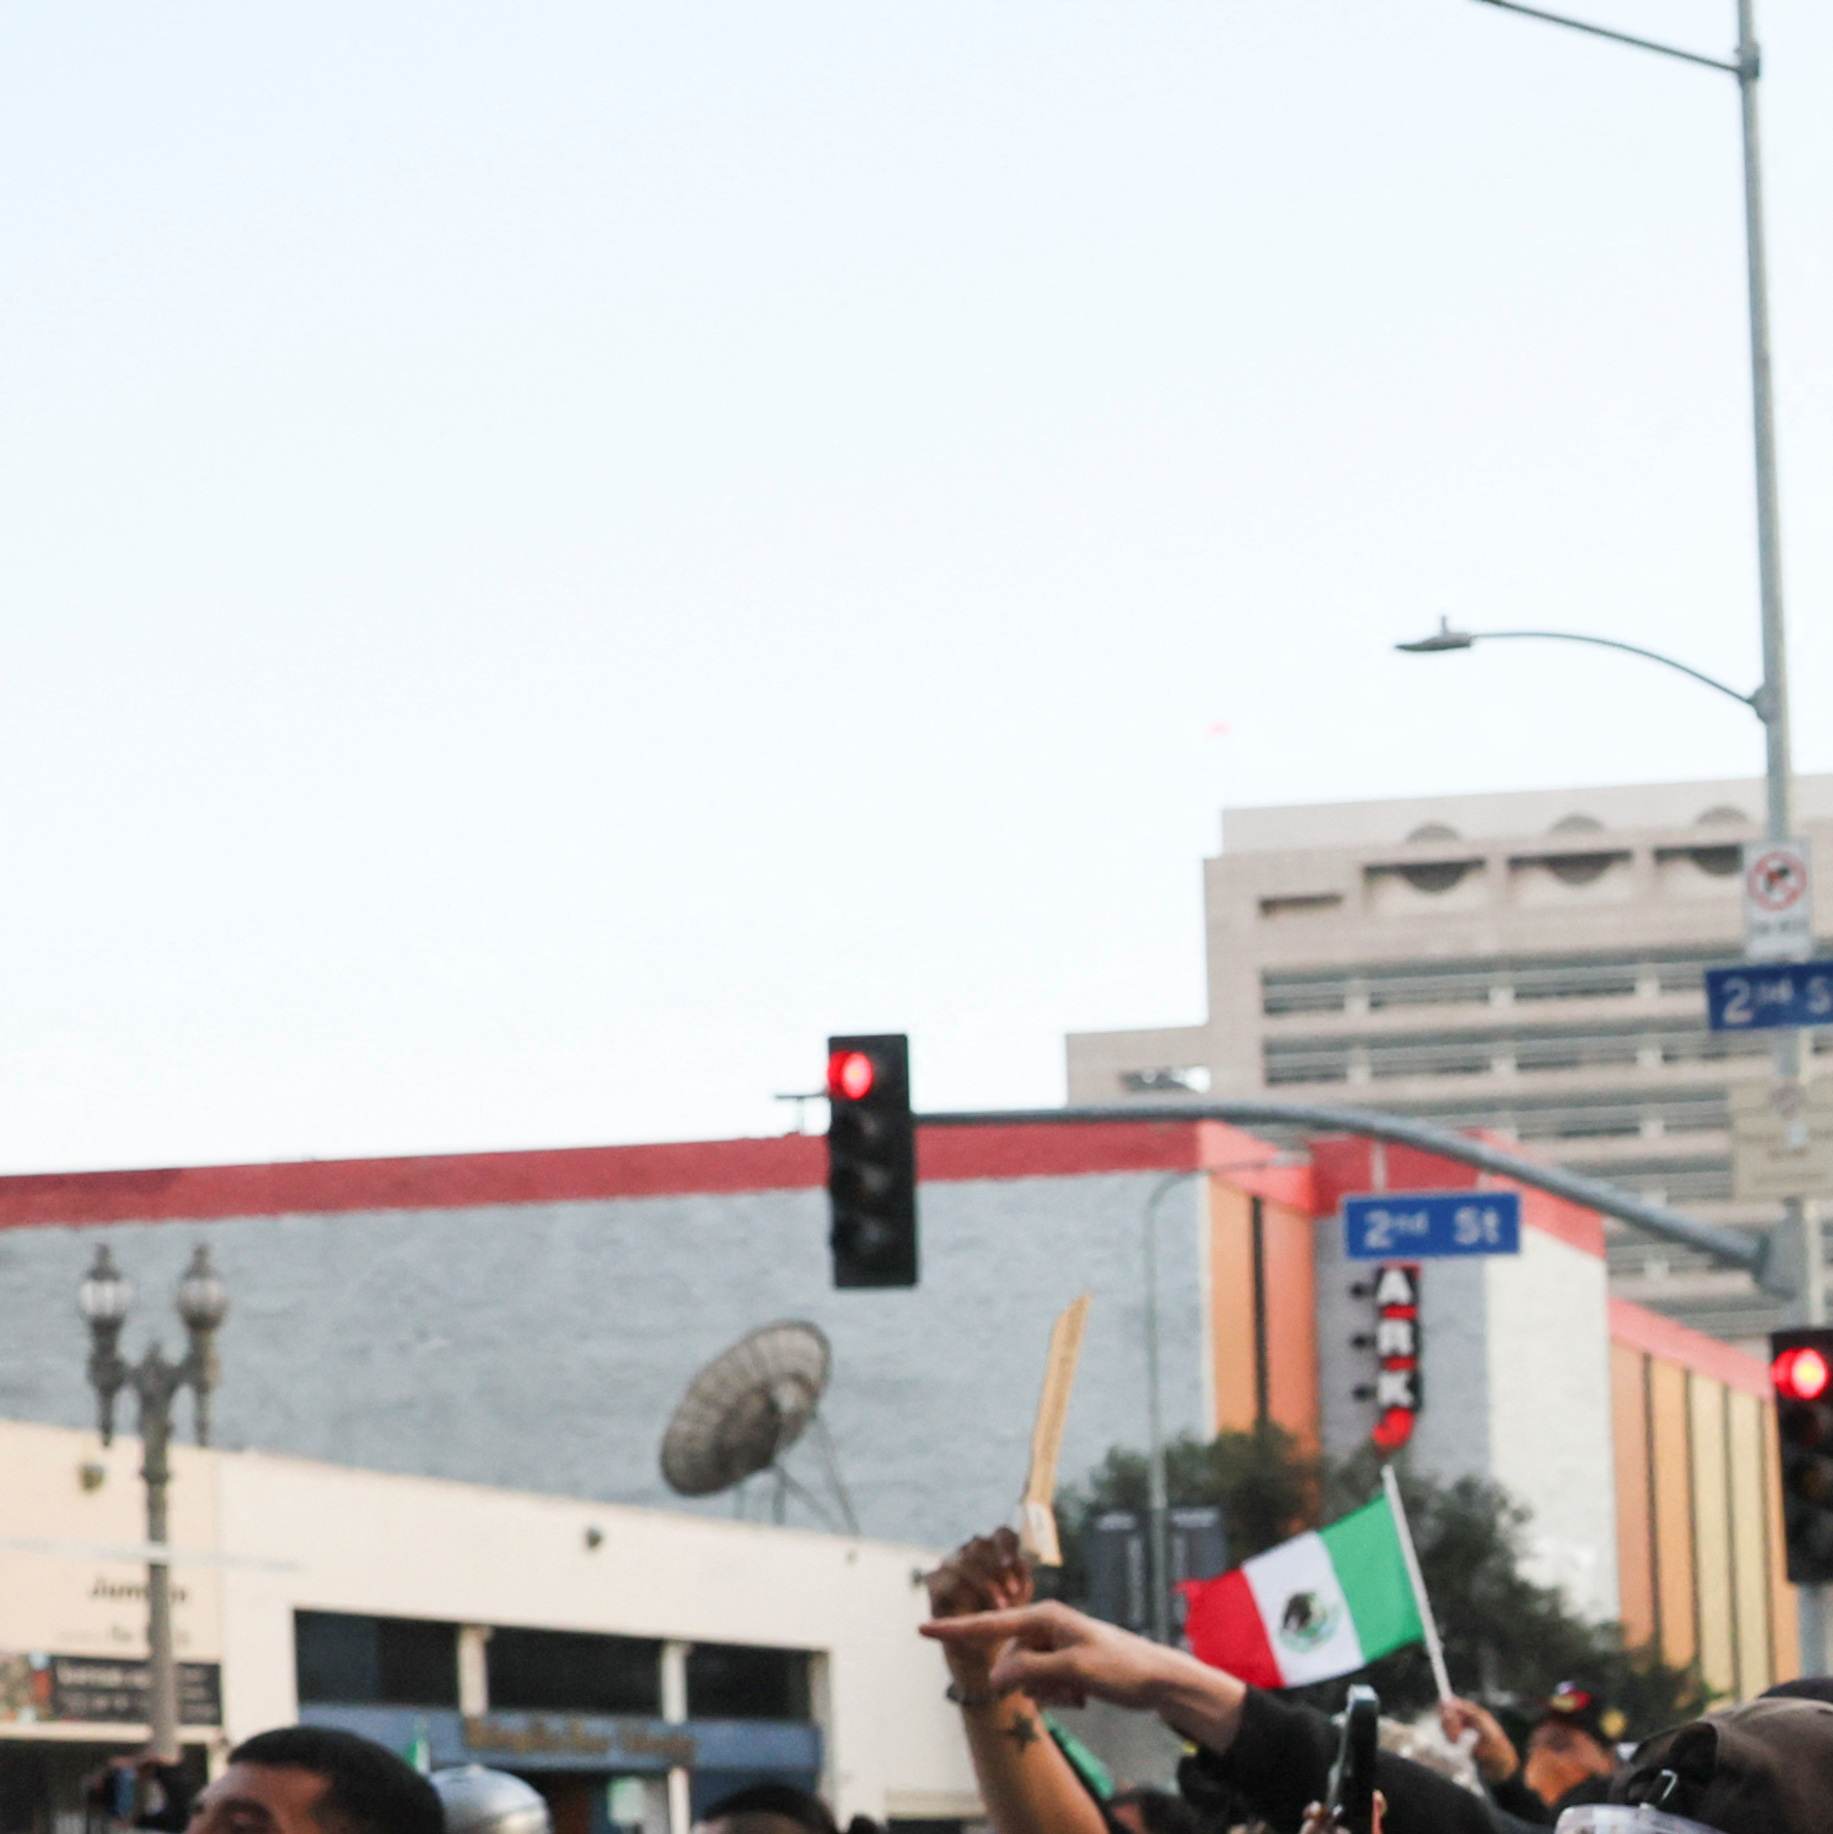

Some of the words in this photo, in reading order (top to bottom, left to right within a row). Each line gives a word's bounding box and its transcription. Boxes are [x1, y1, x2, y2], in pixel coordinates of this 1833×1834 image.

[1723, 976, 1794, 1024] 2nd
[1363, 1208, 1429, 1249] 2nd
[1455, 1205, 1501, 1245] St
[1376, 1268, 1415, 1406] ARK
